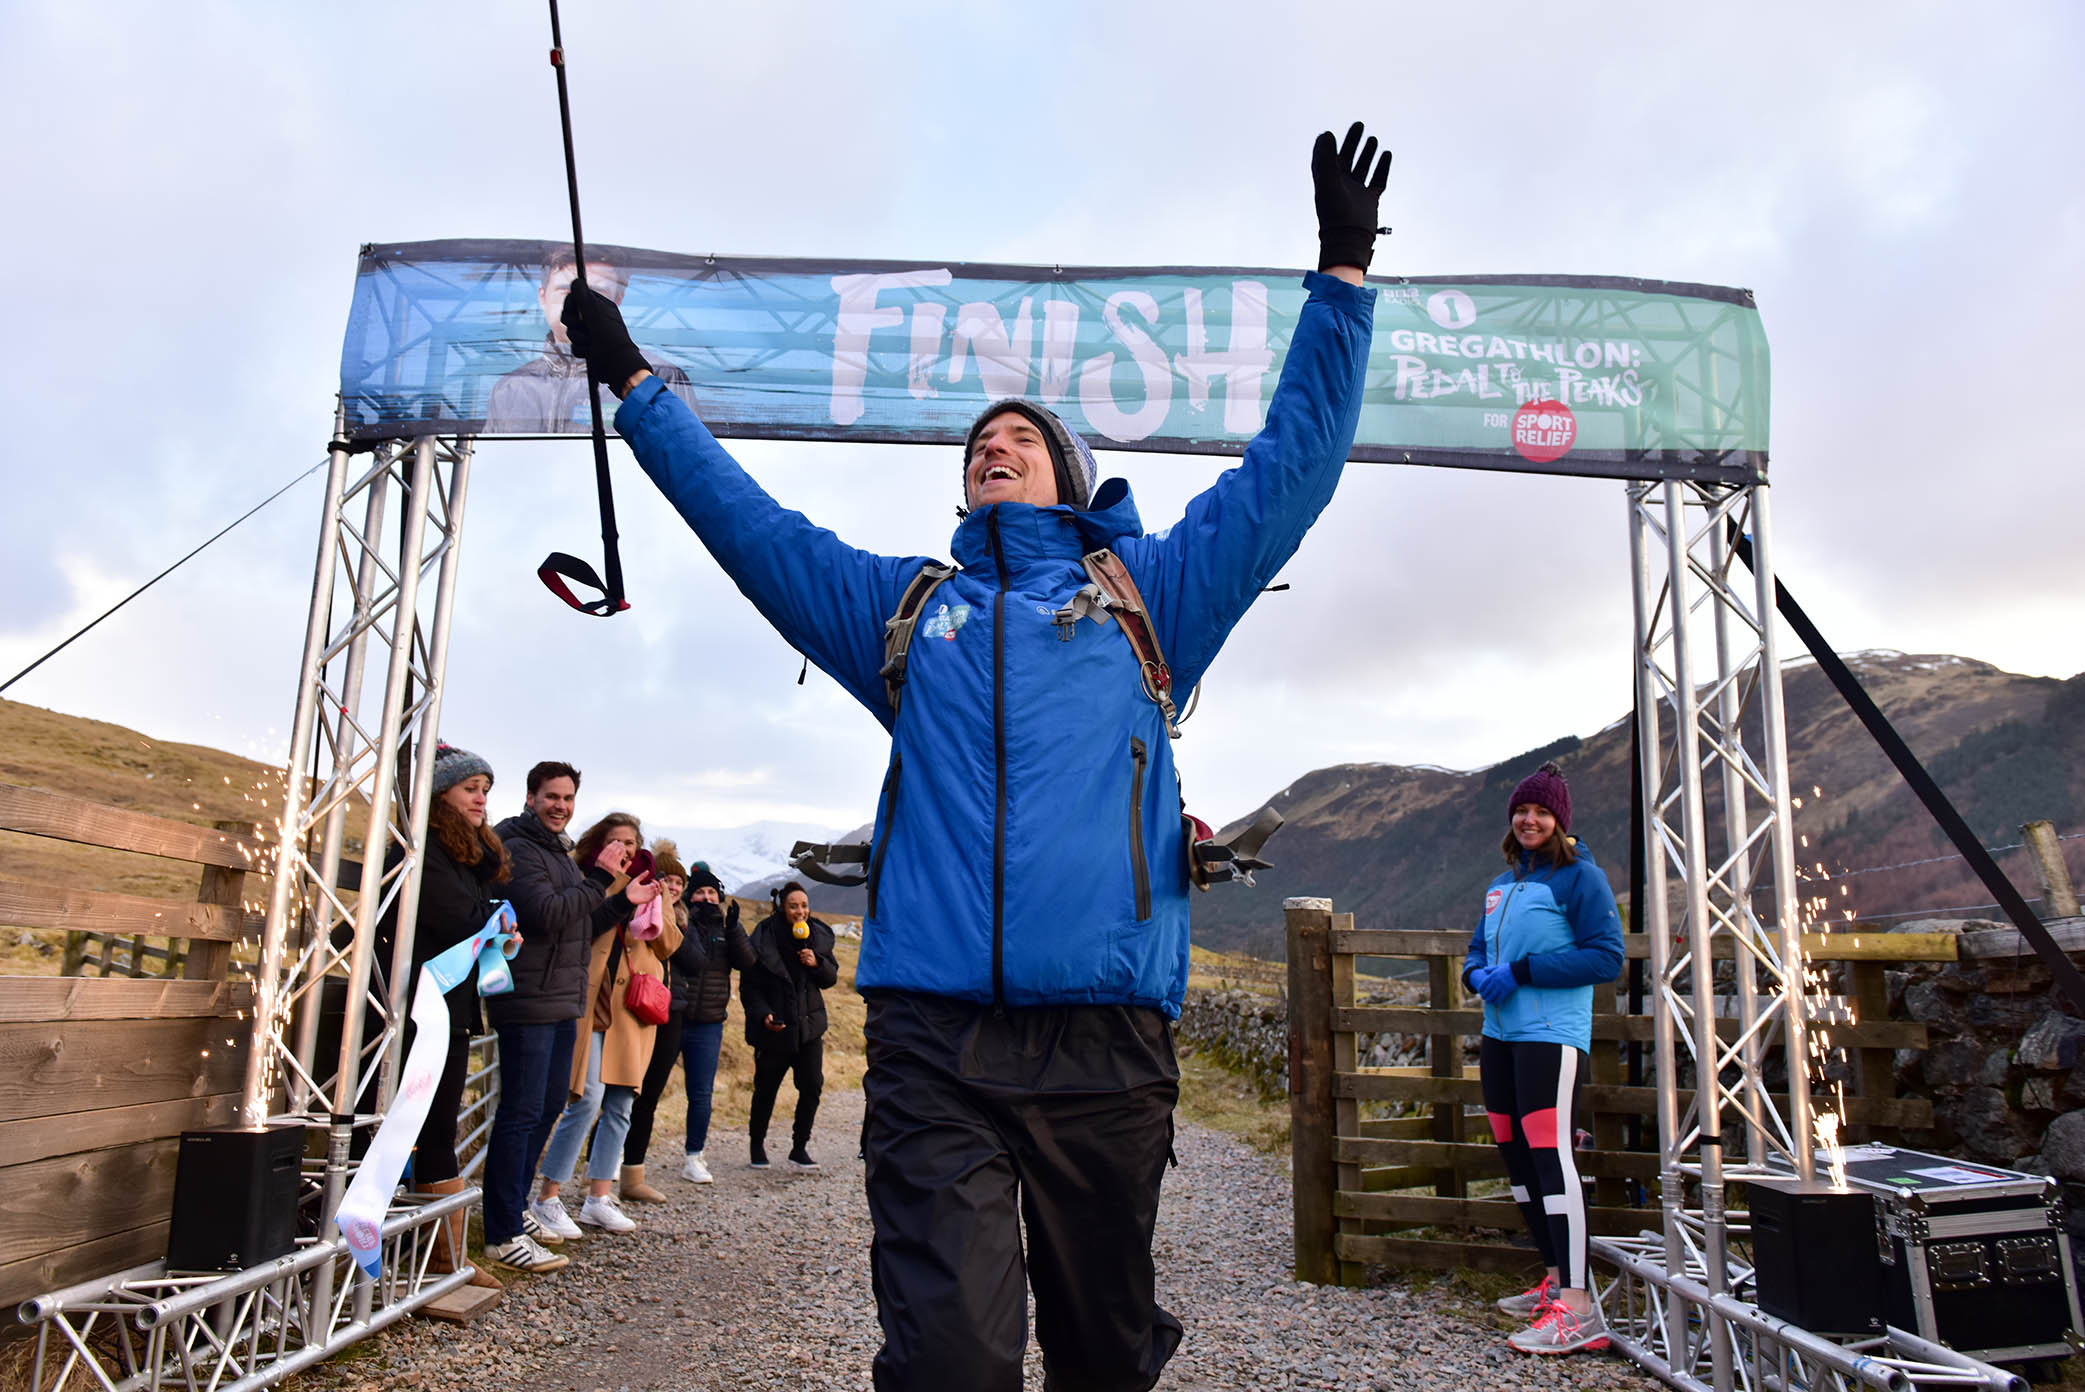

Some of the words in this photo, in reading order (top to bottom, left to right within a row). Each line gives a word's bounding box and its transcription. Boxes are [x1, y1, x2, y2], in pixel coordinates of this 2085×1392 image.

[830, 268, 1277, 443] FINISH
[1390, 329, 1641, 369] GREGATHLON:
[1390, 354, 1503, 400] PEDAL
[1512, 380, 1555, 406] THE
[1553, 367, 1643, 408] PEAKS
[1483, 412, 1509, 429] FOR
[1517, 413, 1573, 431] SPORT
[1516, 429, 1573, 447] RELIEF
